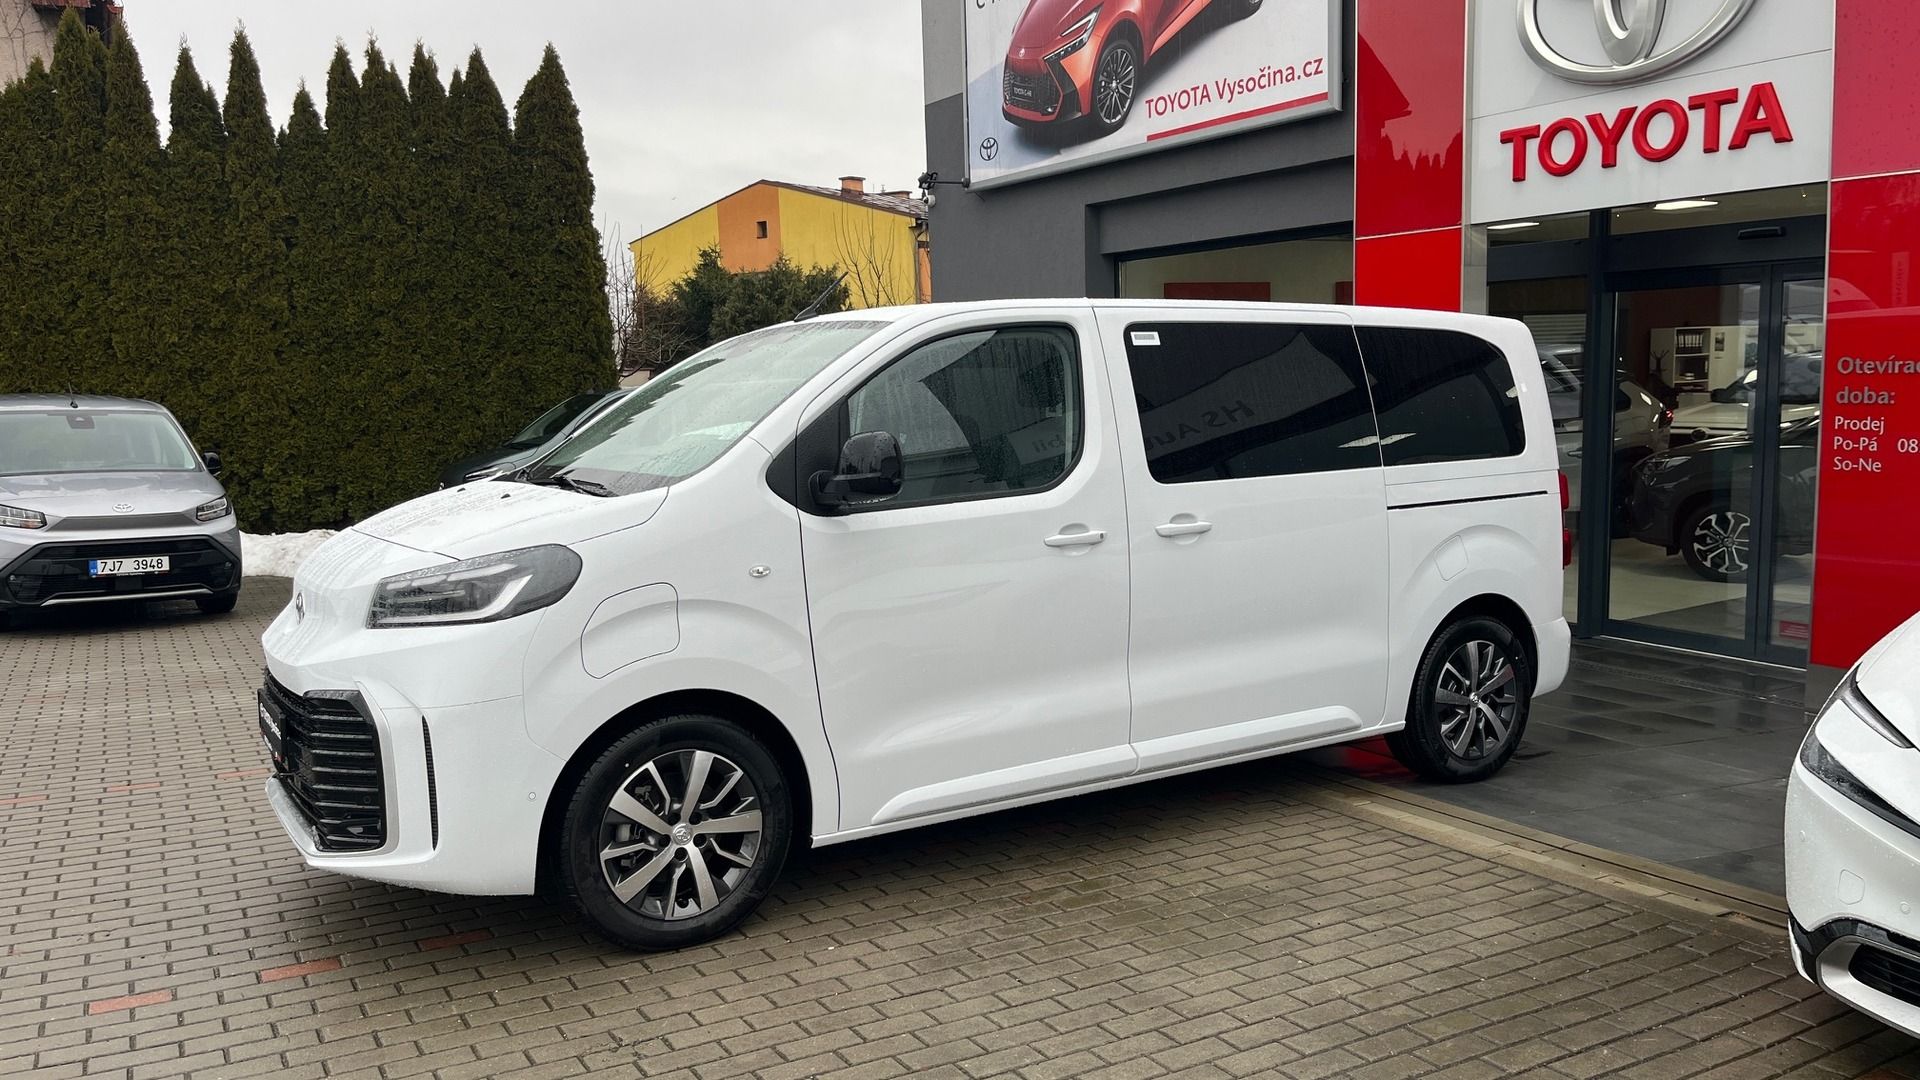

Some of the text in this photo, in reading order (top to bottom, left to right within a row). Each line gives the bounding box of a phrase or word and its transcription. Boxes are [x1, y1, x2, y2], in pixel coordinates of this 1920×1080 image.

[1145, 57, 1324, 119] TOYOTA Vysočina.cz
[1500, 82, 1794, 182] TOYOTA
[1836, 386, 1896, 404] doba:
[1834, 416, 1885, 435] Prodej
[1834, 436, 1878, 451] Po-Pá
[1833, 456, 1882, 472] So-Ne
[100, 558, 163, 572] 7J7 3948
